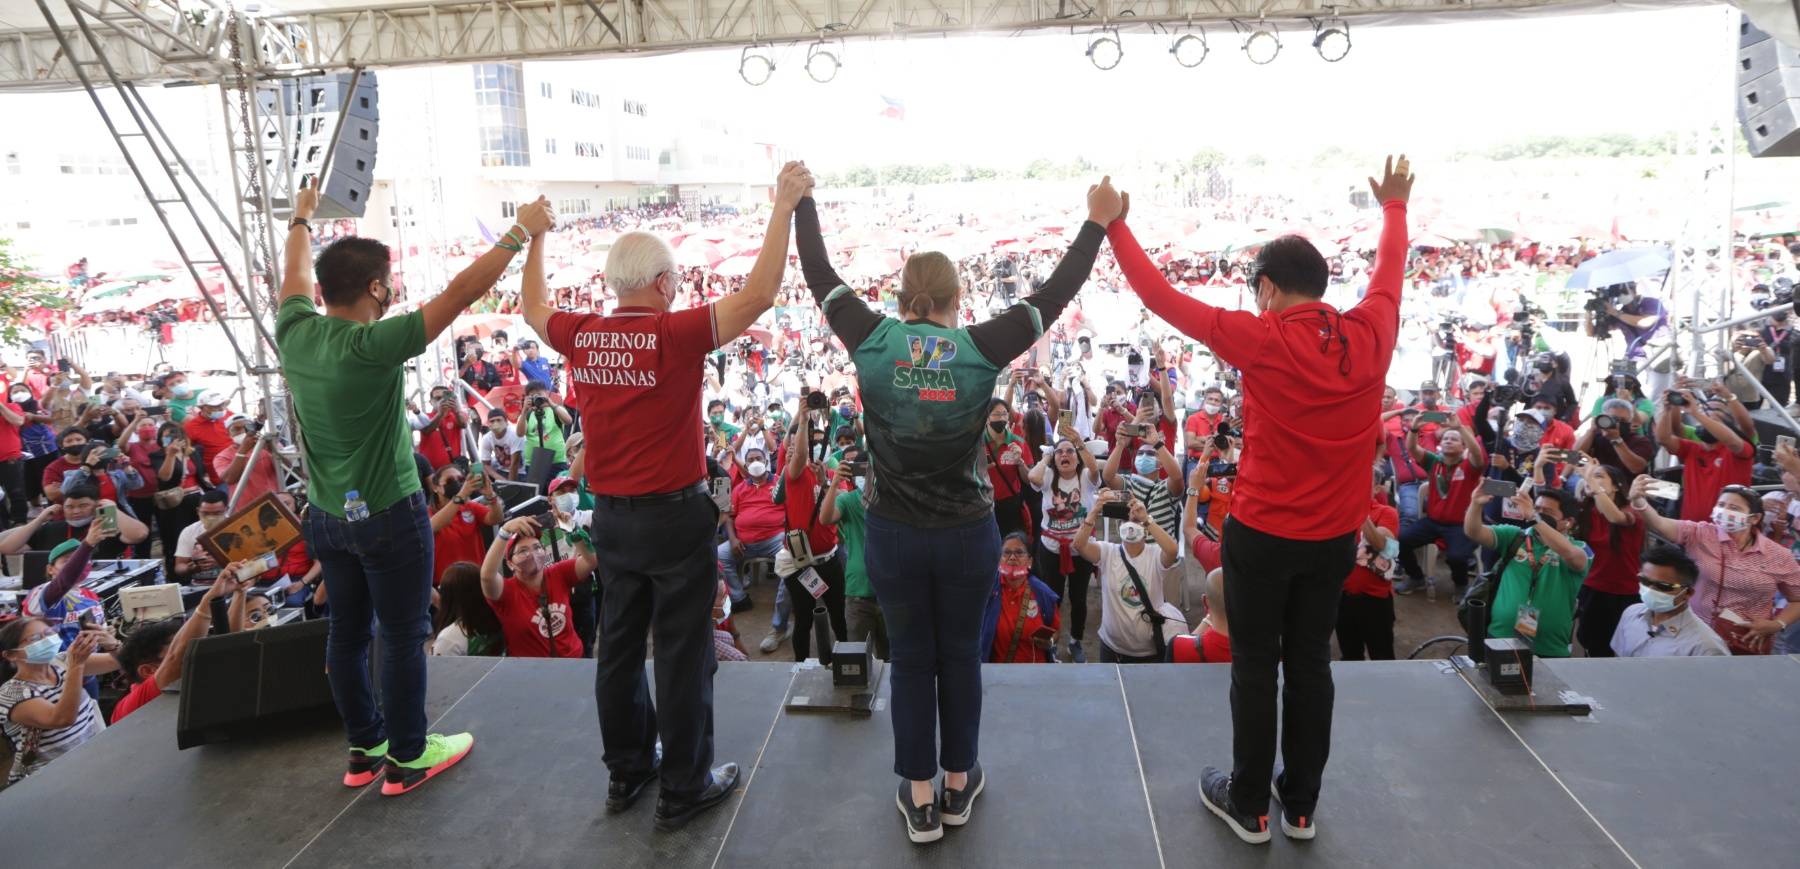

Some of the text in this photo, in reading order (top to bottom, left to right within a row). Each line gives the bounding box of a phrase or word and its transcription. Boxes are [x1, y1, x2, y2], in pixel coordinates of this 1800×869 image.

[575, 332, 657, 350] GOVERNOR
[587, 351, 634, 368] DODO
[906, 335, 957, 368] VP
[573, 367, 657, 387] MANDANAS
[893, 366, 957, 390] SARA
[918, 388, 956, 401] 2022
[808, 577, 819, 589] VIP
